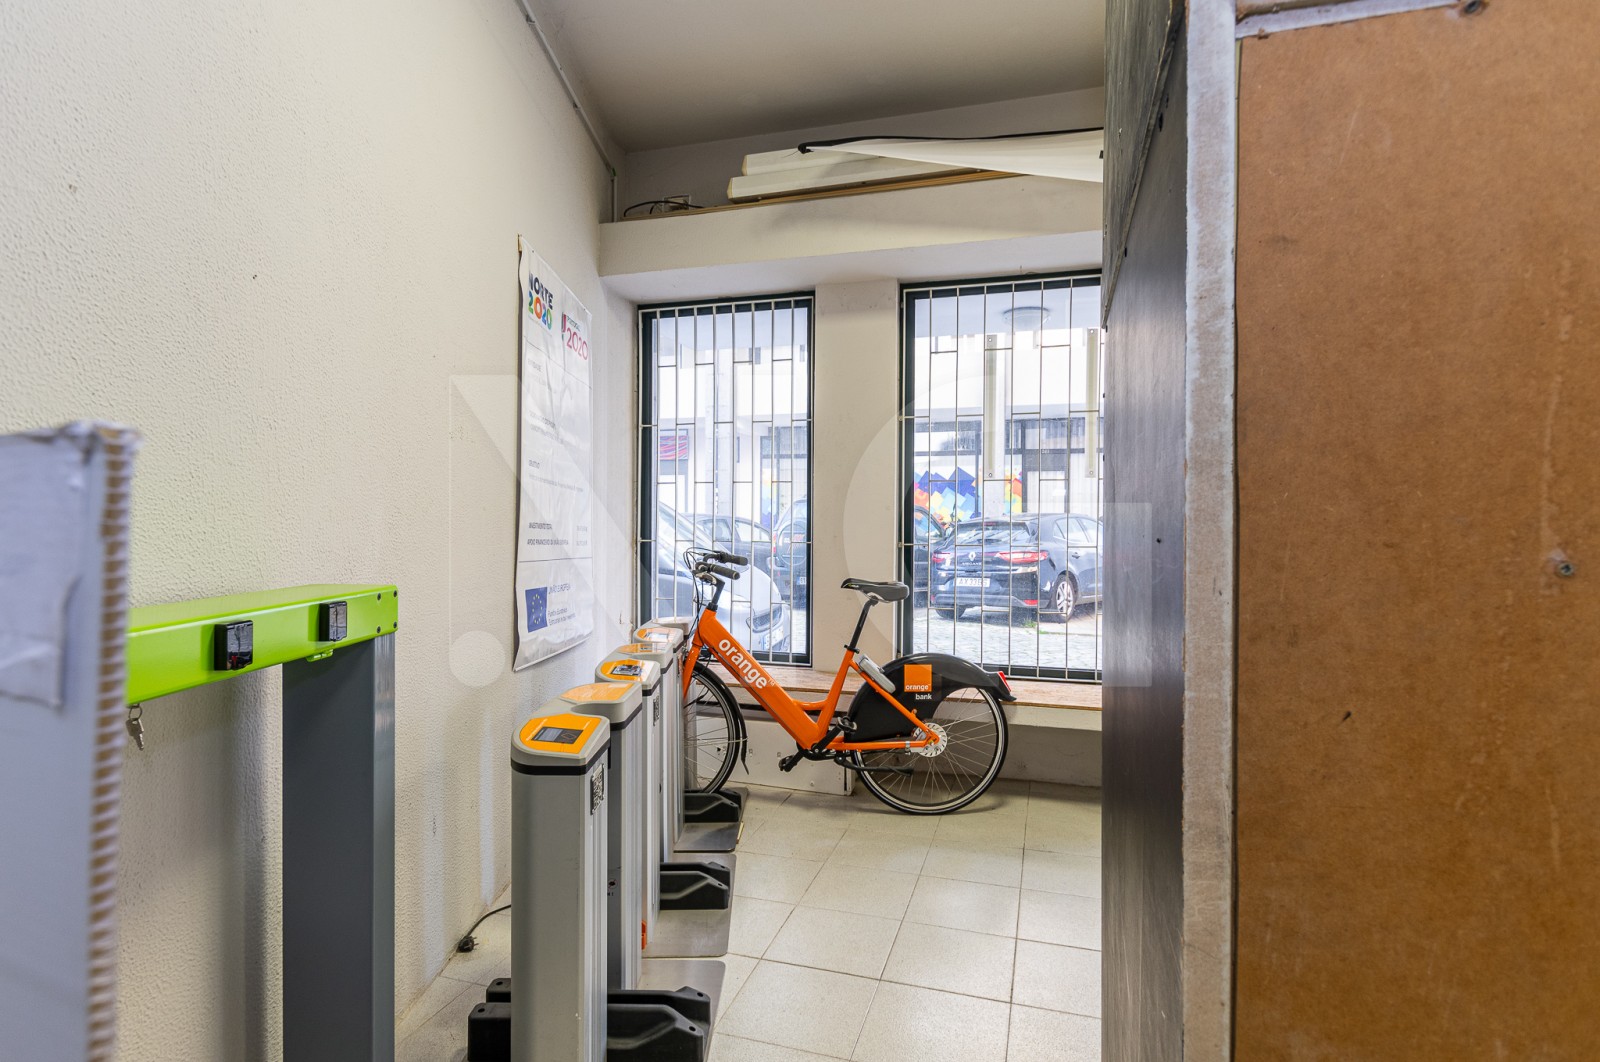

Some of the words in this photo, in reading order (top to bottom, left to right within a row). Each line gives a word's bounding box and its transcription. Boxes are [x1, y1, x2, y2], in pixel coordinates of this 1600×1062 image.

[528, 273, 553, 310] NORTE
[528, 291, 553, 330] 2020
[566, 327, 589, 361] 2020
[718, 639, 767, 689] orange
[905, 684, 929, 692] orange
